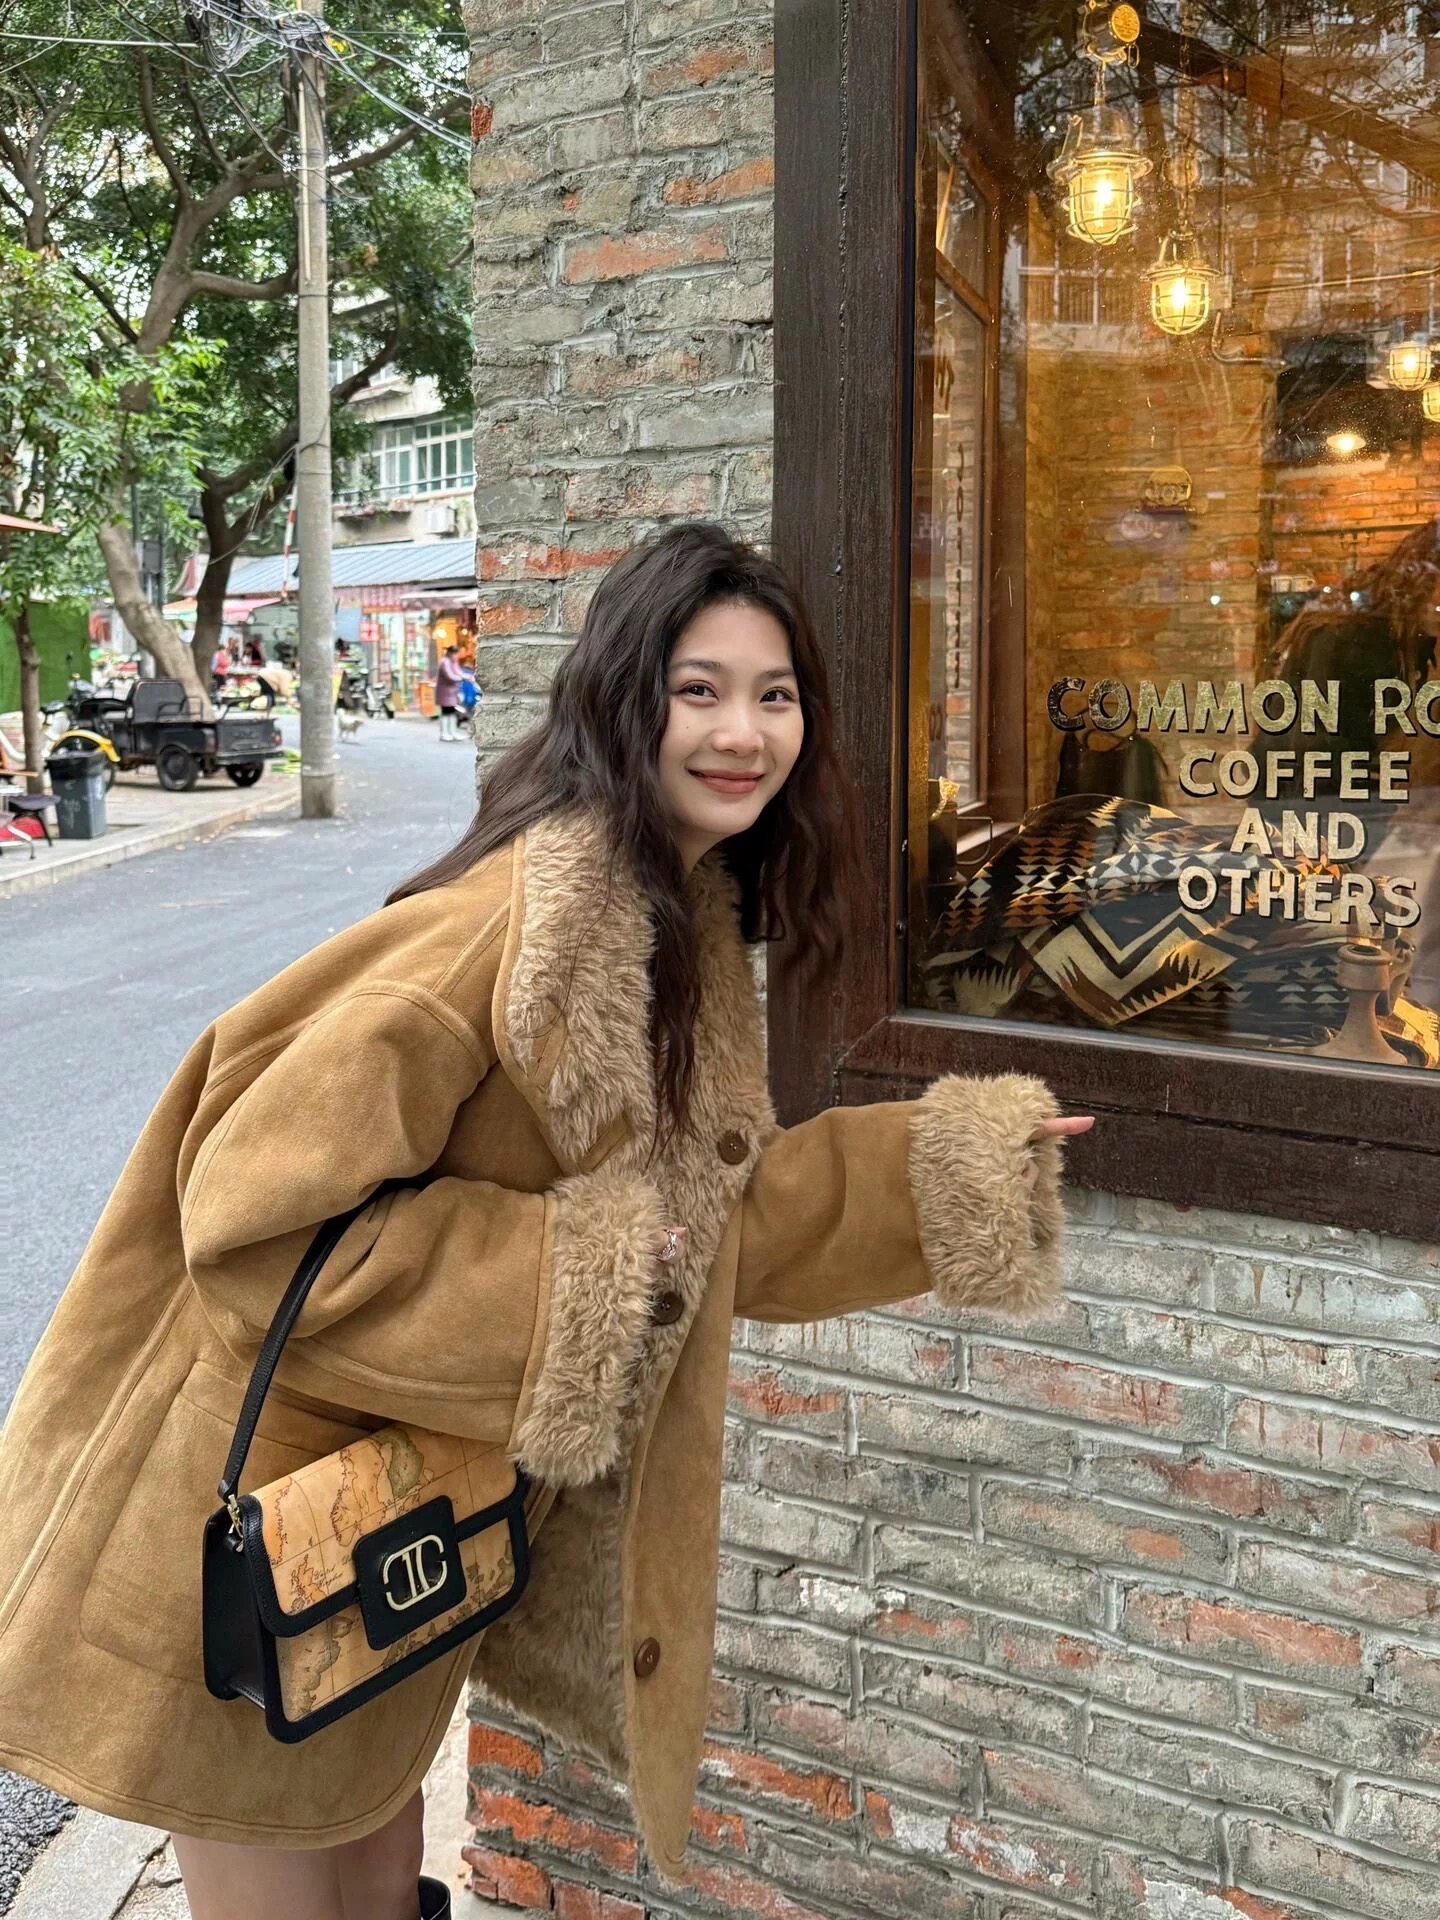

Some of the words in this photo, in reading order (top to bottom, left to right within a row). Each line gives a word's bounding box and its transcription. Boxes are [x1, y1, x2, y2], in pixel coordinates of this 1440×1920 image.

[1047, 676, 1340, 736] COMMON
[1179, 750, 1411, 803] COFFEE
[1230, 807, 1367, 862] AND
[1178, 866, 1421, 928] OTHERS
